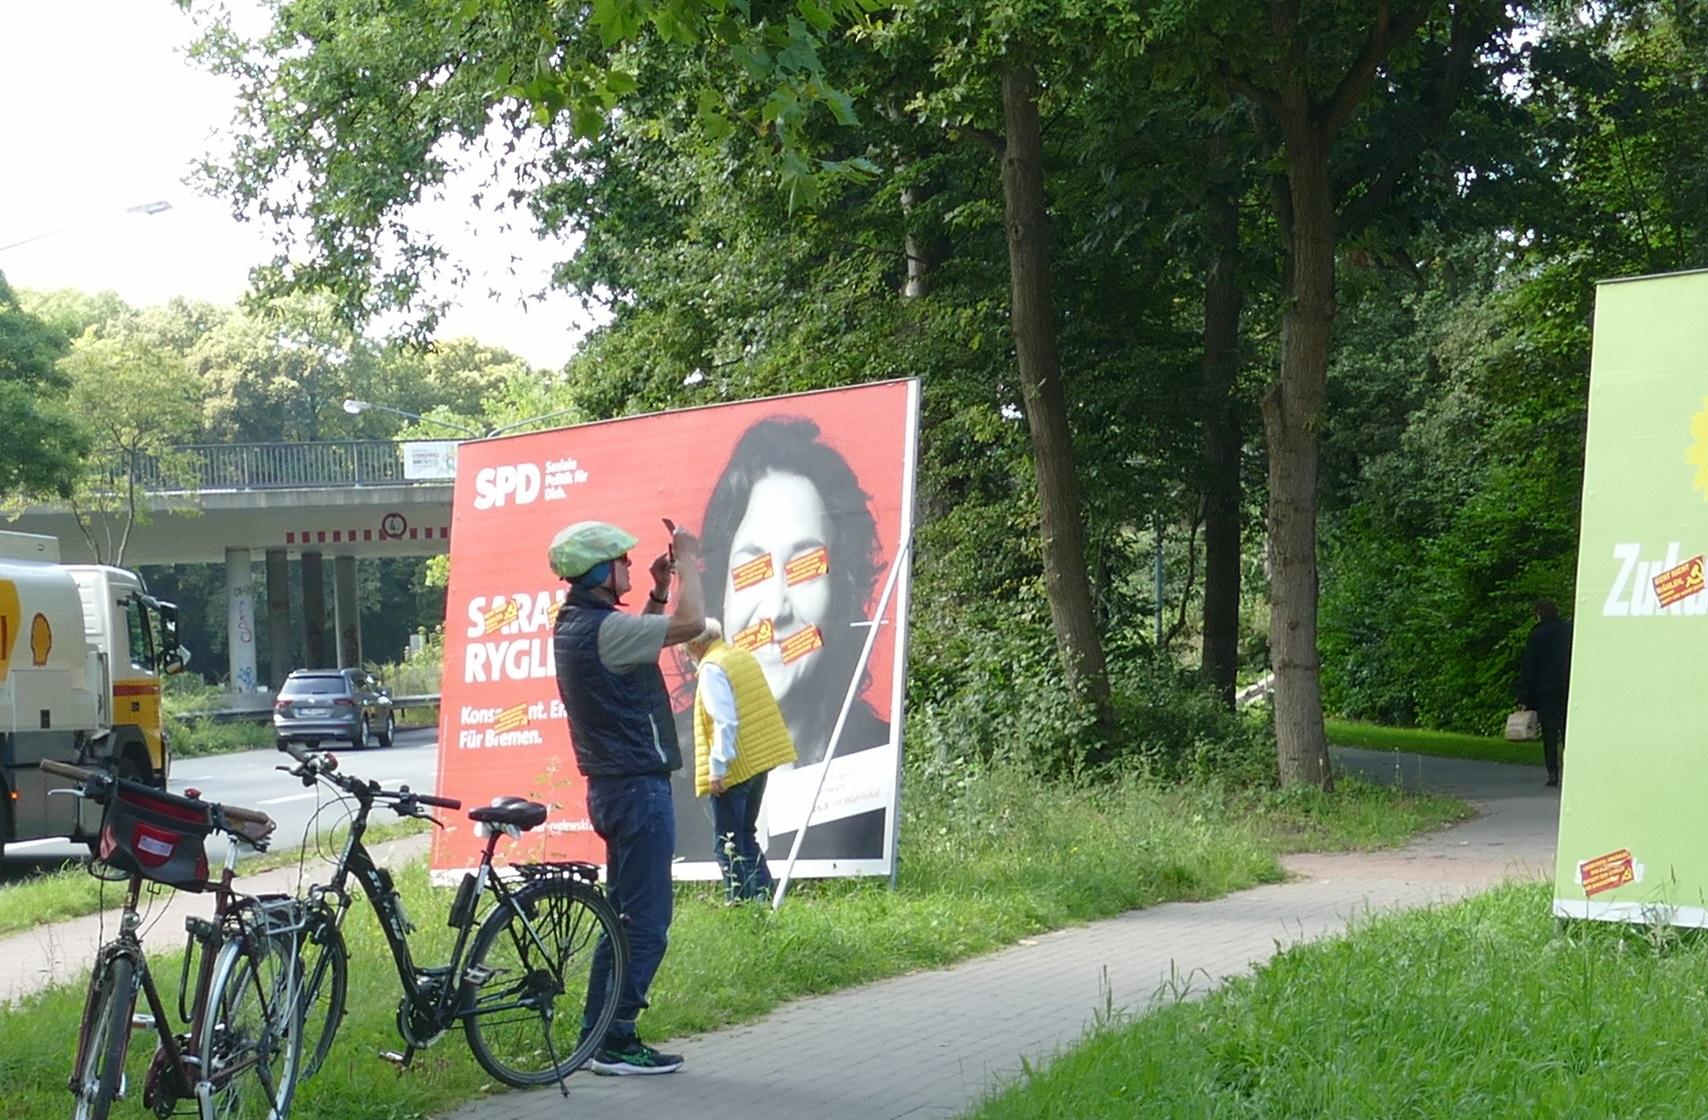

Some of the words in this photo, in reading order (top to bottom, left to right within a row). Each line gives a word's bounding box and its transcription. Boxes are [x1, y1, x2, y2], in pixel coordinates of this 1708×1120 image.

[473, 463, 541, 510] SPD
[467, 589, 567, 638] SARA
[459, 730, 483, 749] Für
[485, 727, 543, 748] Bremen.
